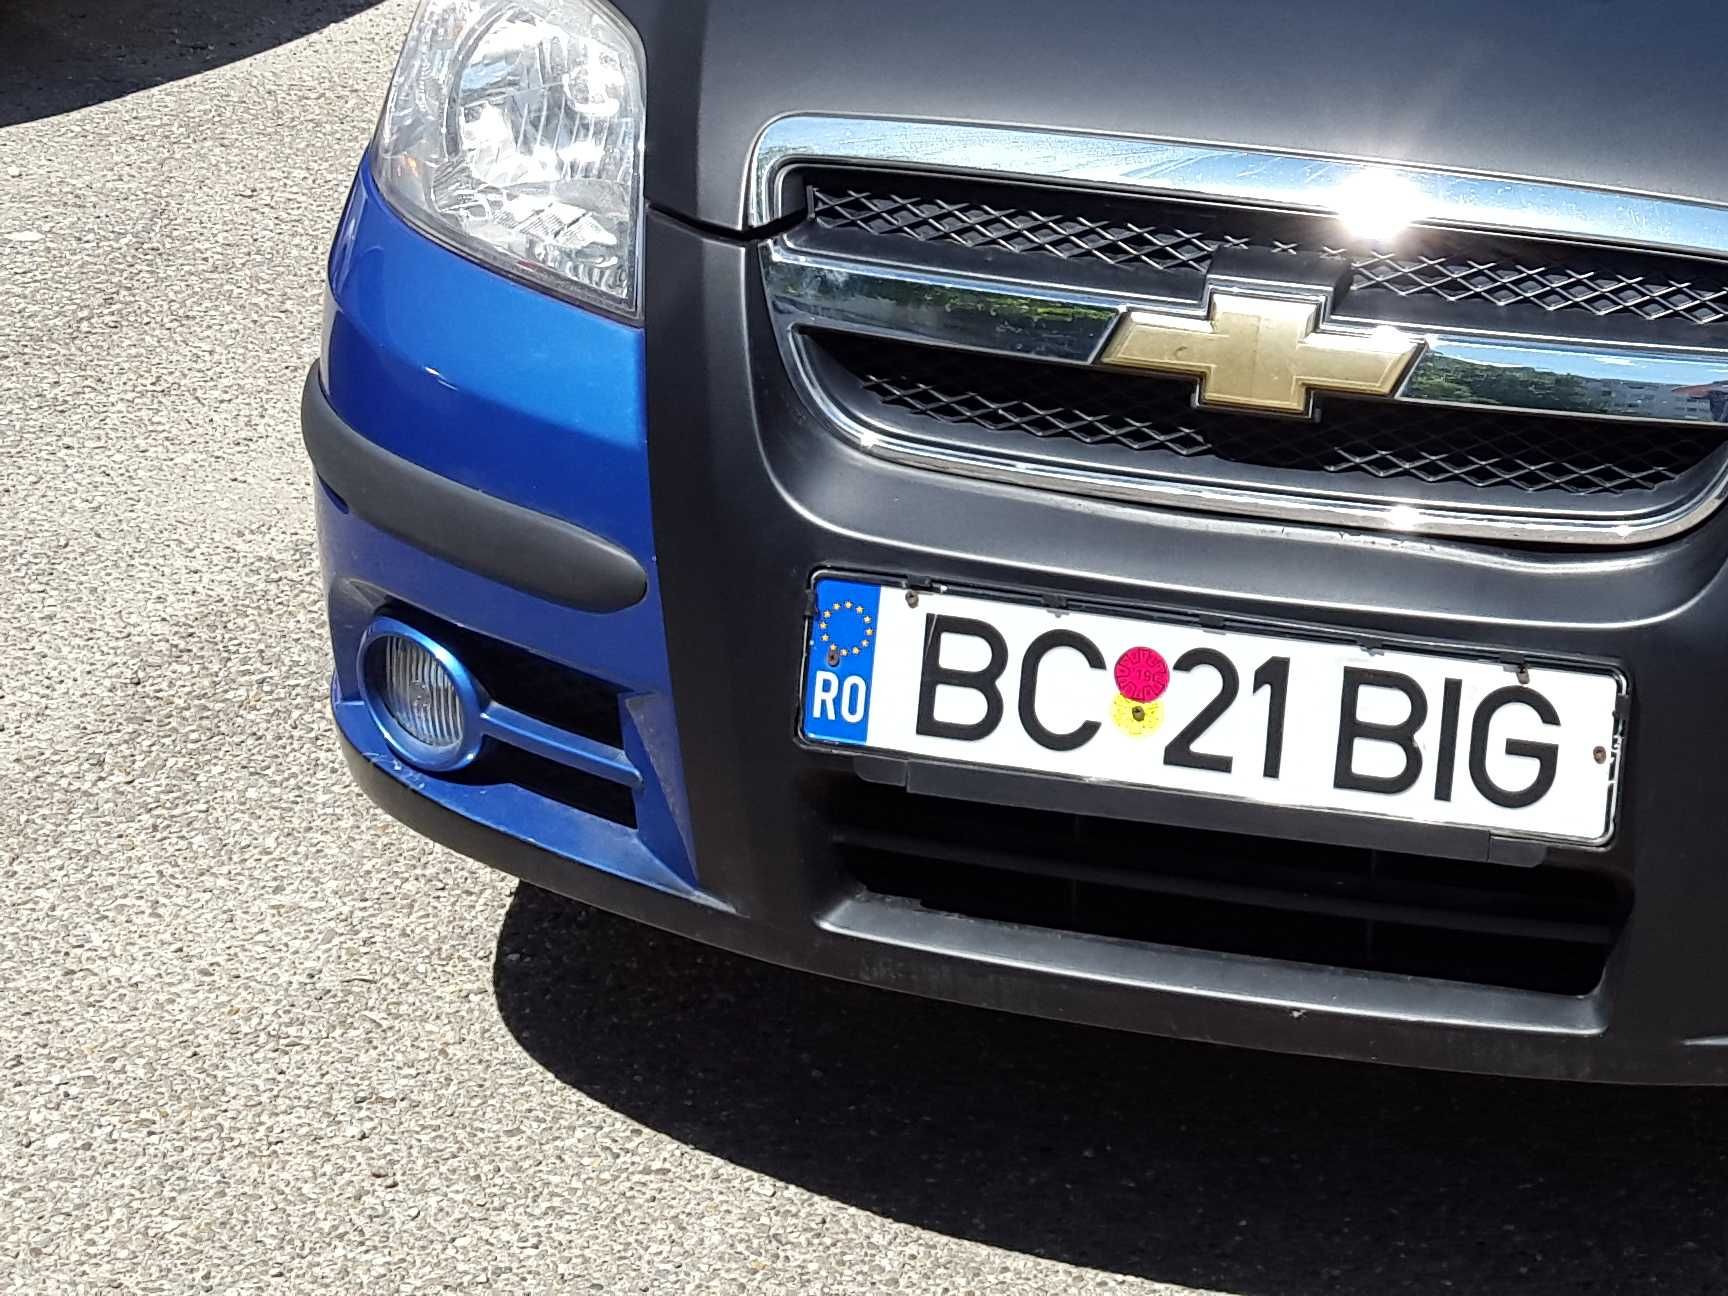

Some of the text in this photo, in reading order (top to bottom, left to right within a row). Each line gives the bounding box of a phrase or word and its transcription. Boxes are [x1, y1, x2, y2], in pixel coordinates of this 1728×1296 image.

[812, 670, 866, 723] RO
[916, 613, 1562, 809] BC 21 BIG
